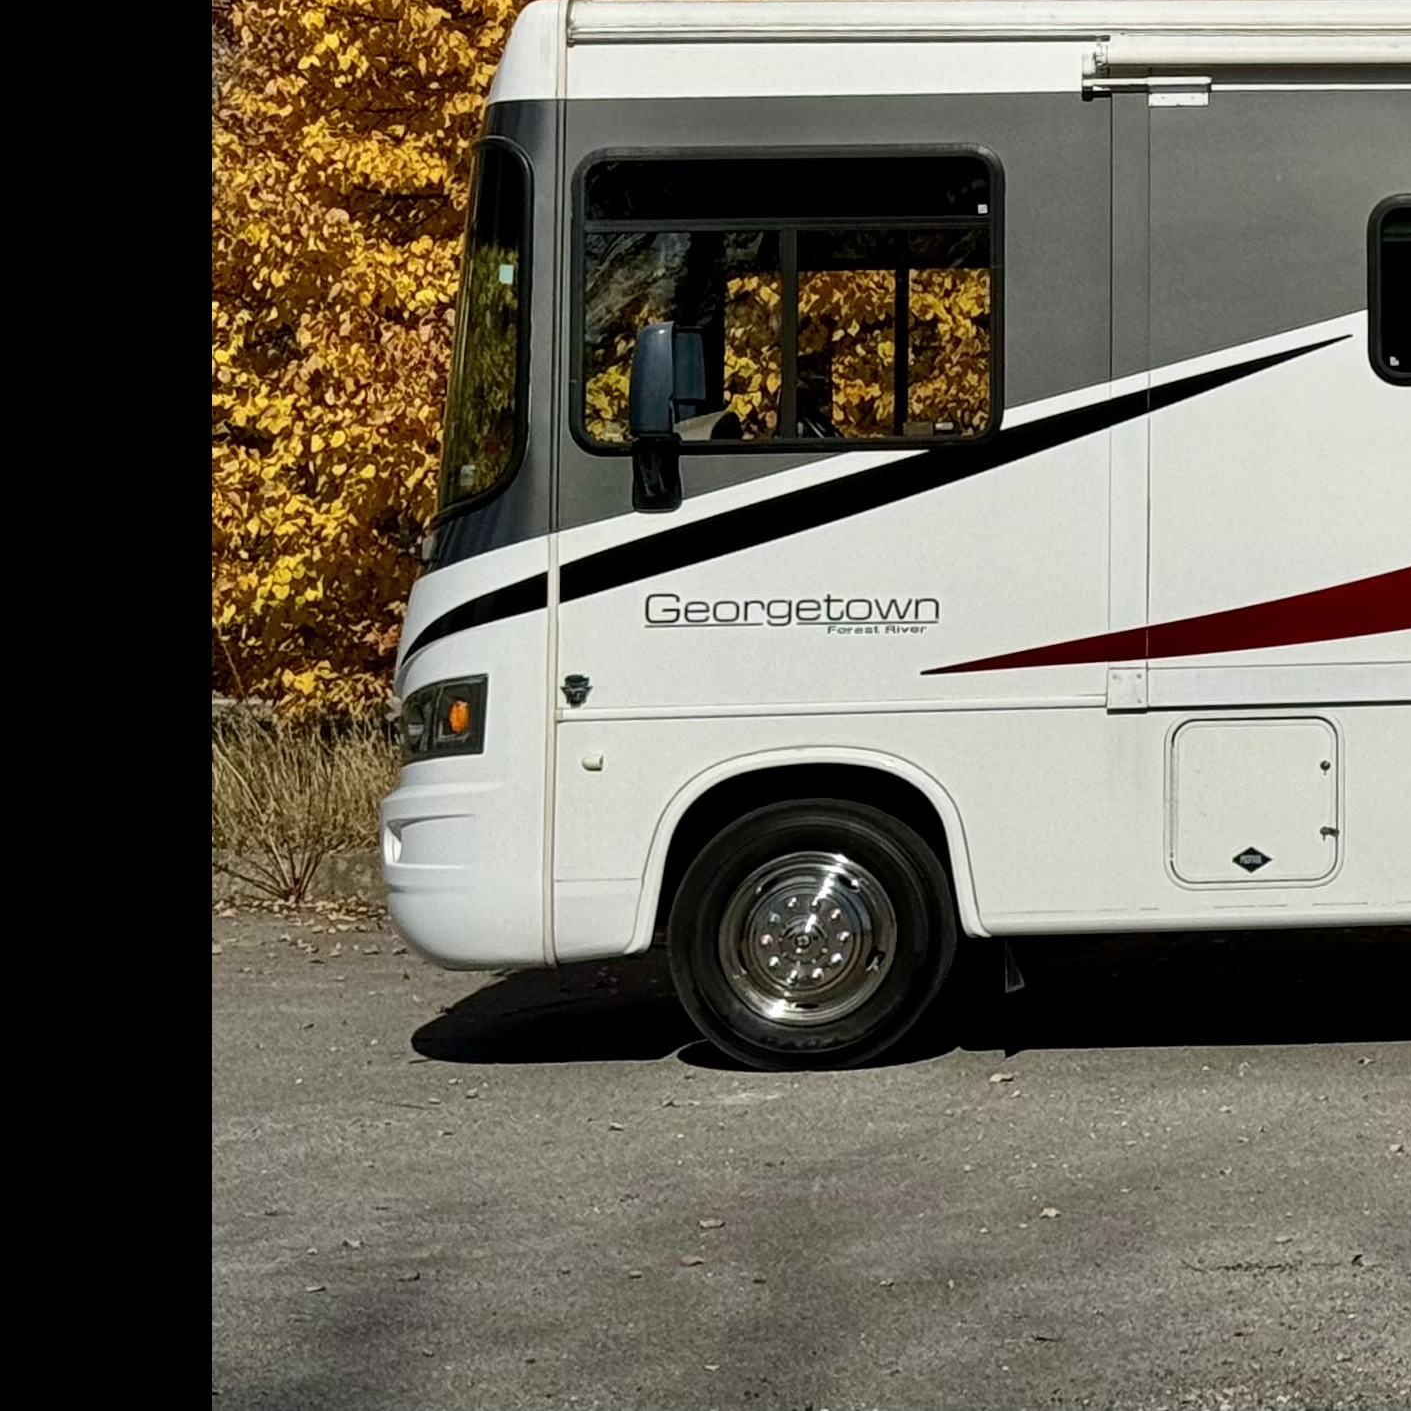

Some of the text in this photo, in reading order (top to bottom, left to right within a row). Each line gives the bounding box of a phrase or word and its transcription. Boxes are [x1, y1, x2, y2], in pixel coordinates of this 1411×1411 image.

[644, 593, 940, 627] Georgetown
[826, 624, 928, 635] Forest River
